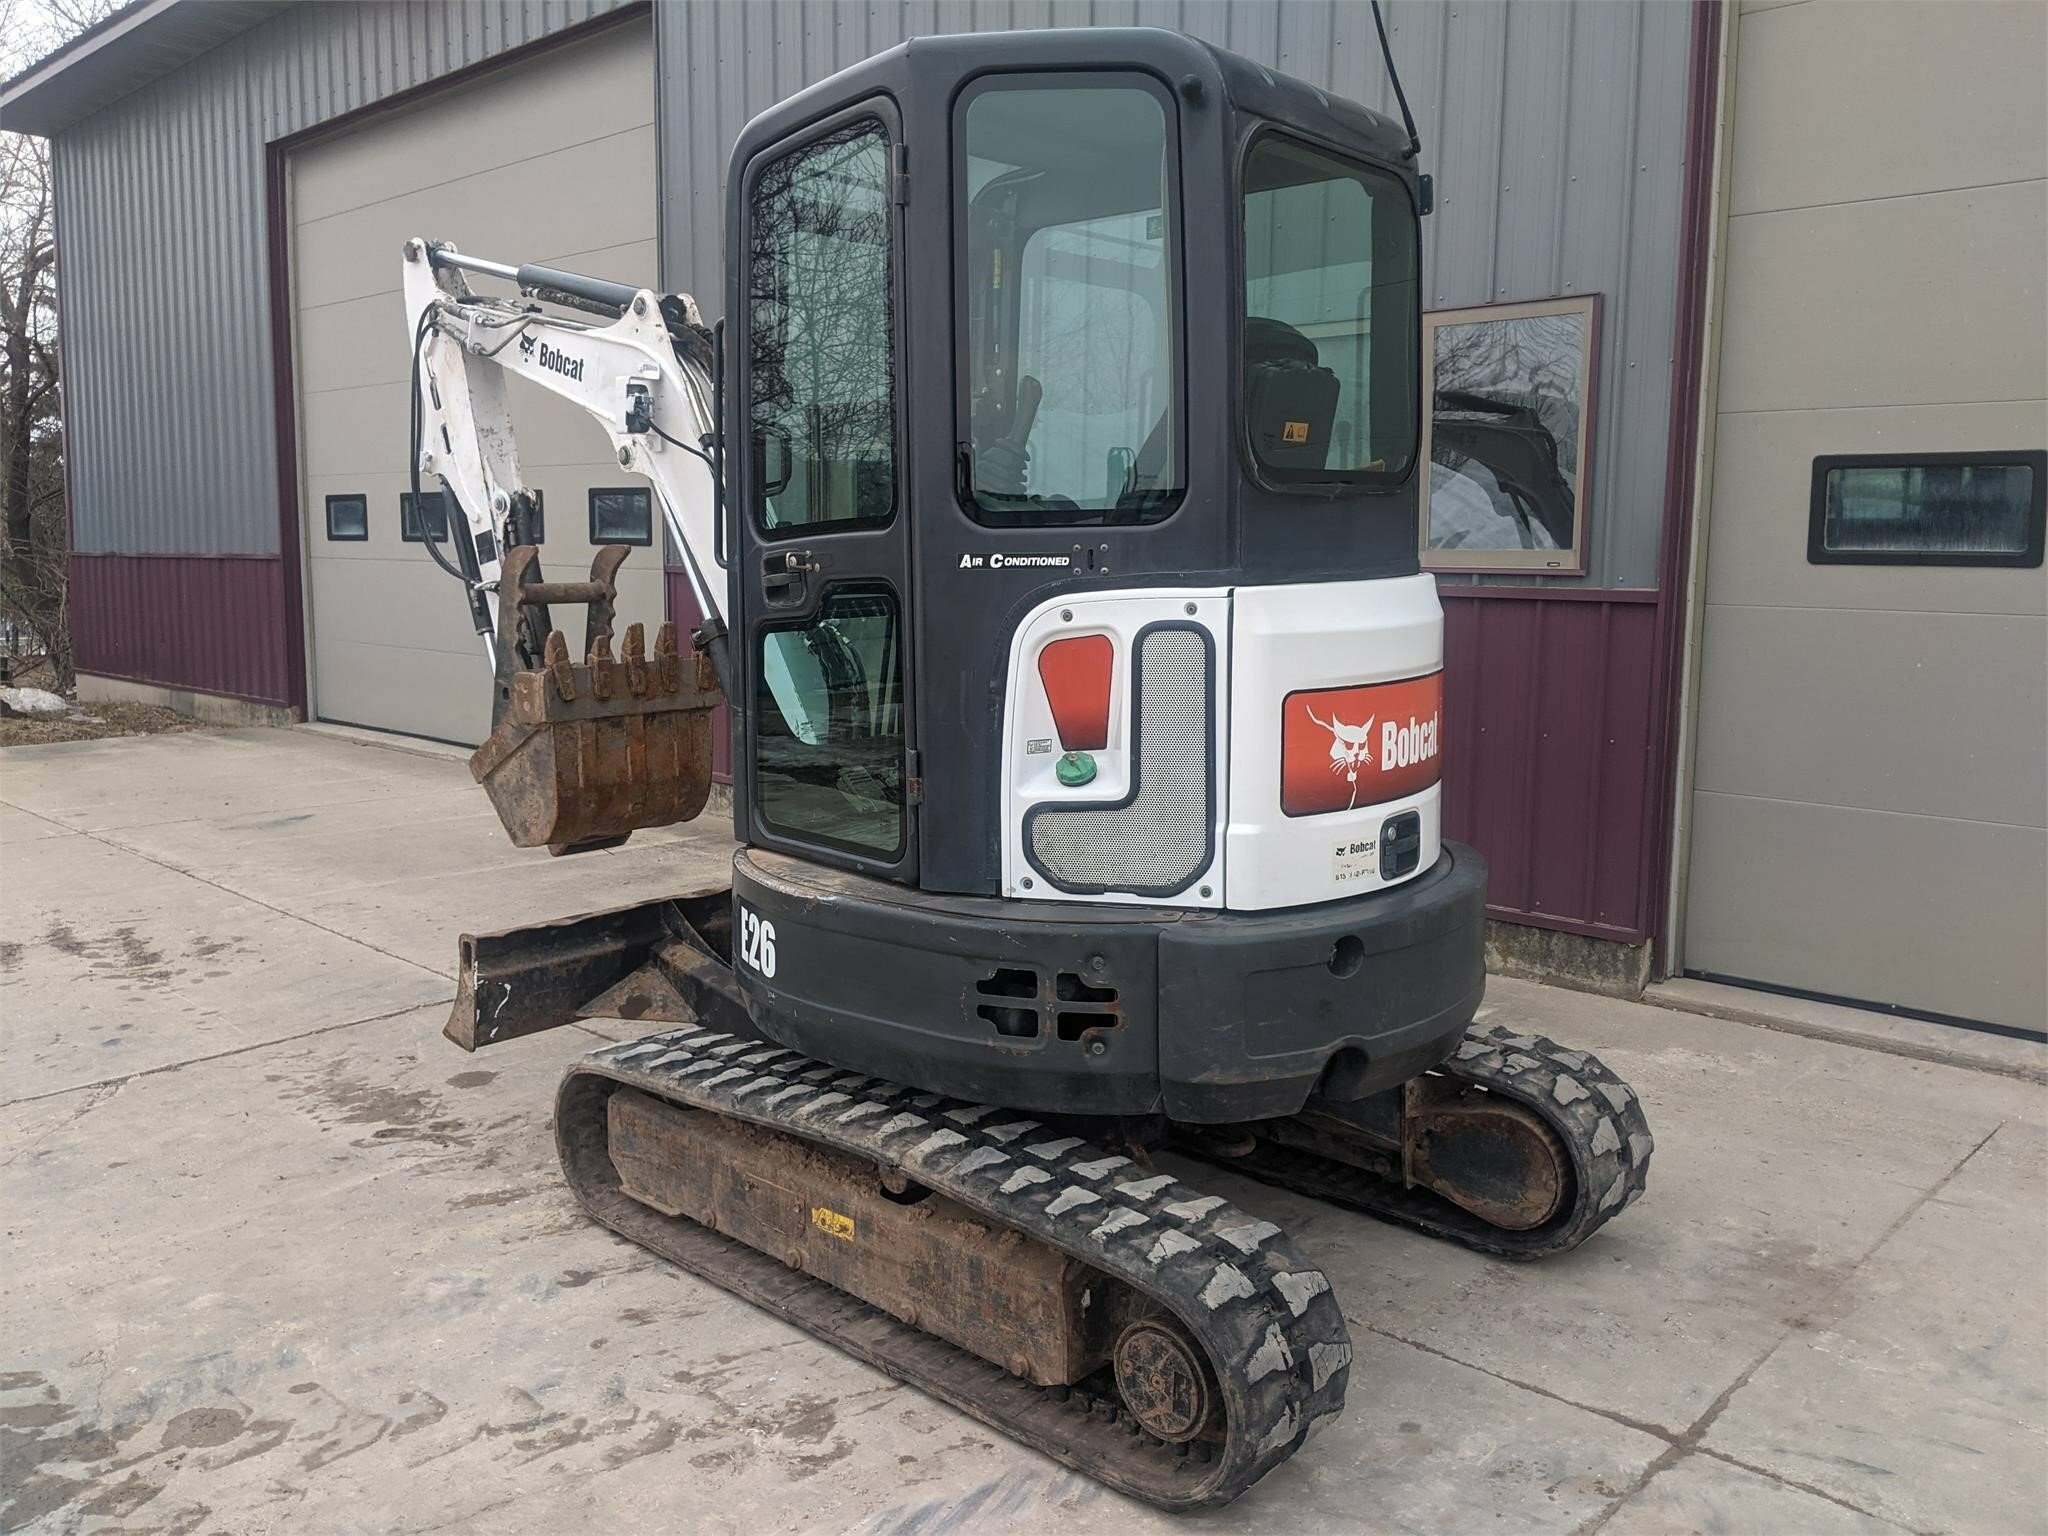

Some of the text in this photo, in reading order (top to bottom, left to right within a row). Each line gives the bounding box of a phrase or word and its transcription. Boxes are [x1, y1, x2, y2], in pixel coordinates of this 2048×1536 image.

[539, 342, 584, 383] Bobcat
[990, 553, 1070, 569] CONDITIONED
[1381, 710, 1438, 771] Bobcat
[1350, 840, 1376, 855] Bobcat
[741, 905, 776, 978] E26
